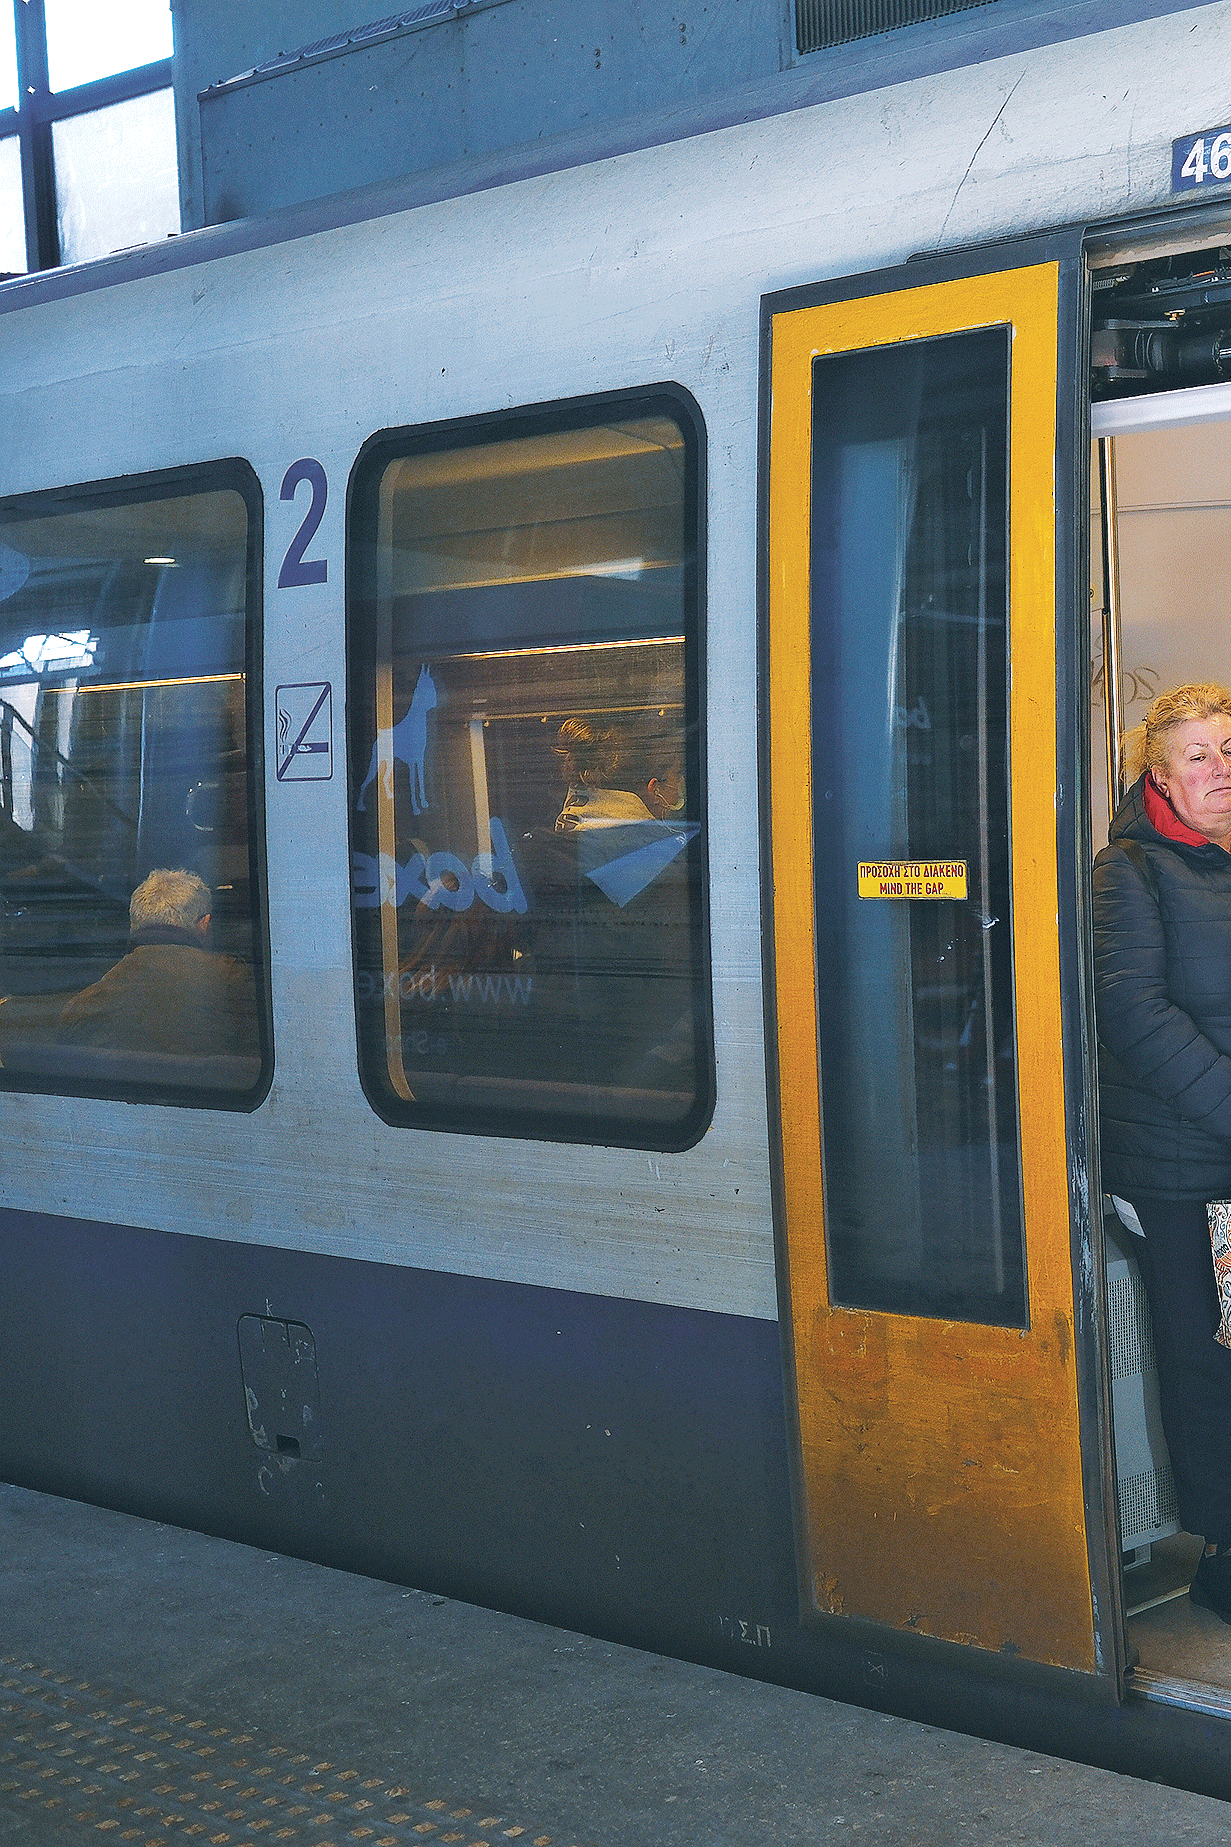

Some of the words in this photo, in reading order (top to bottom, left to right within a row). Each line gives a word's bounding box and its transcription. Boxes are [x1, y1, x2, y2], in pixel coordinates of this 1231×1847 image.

[278, 458, 328, 588] 2
[860, 865, 901, 878] ΠΡΟΣΟΧΗ
[903, 865, 921, 878] ΣΤΟ
[923, 864, 964, 878] ΔΙΑΚΕΝΟ
[879, 882, 903, 895] MIND
[905, 882, 923, 895] THE
[925, 882, 944, 895] GAP
